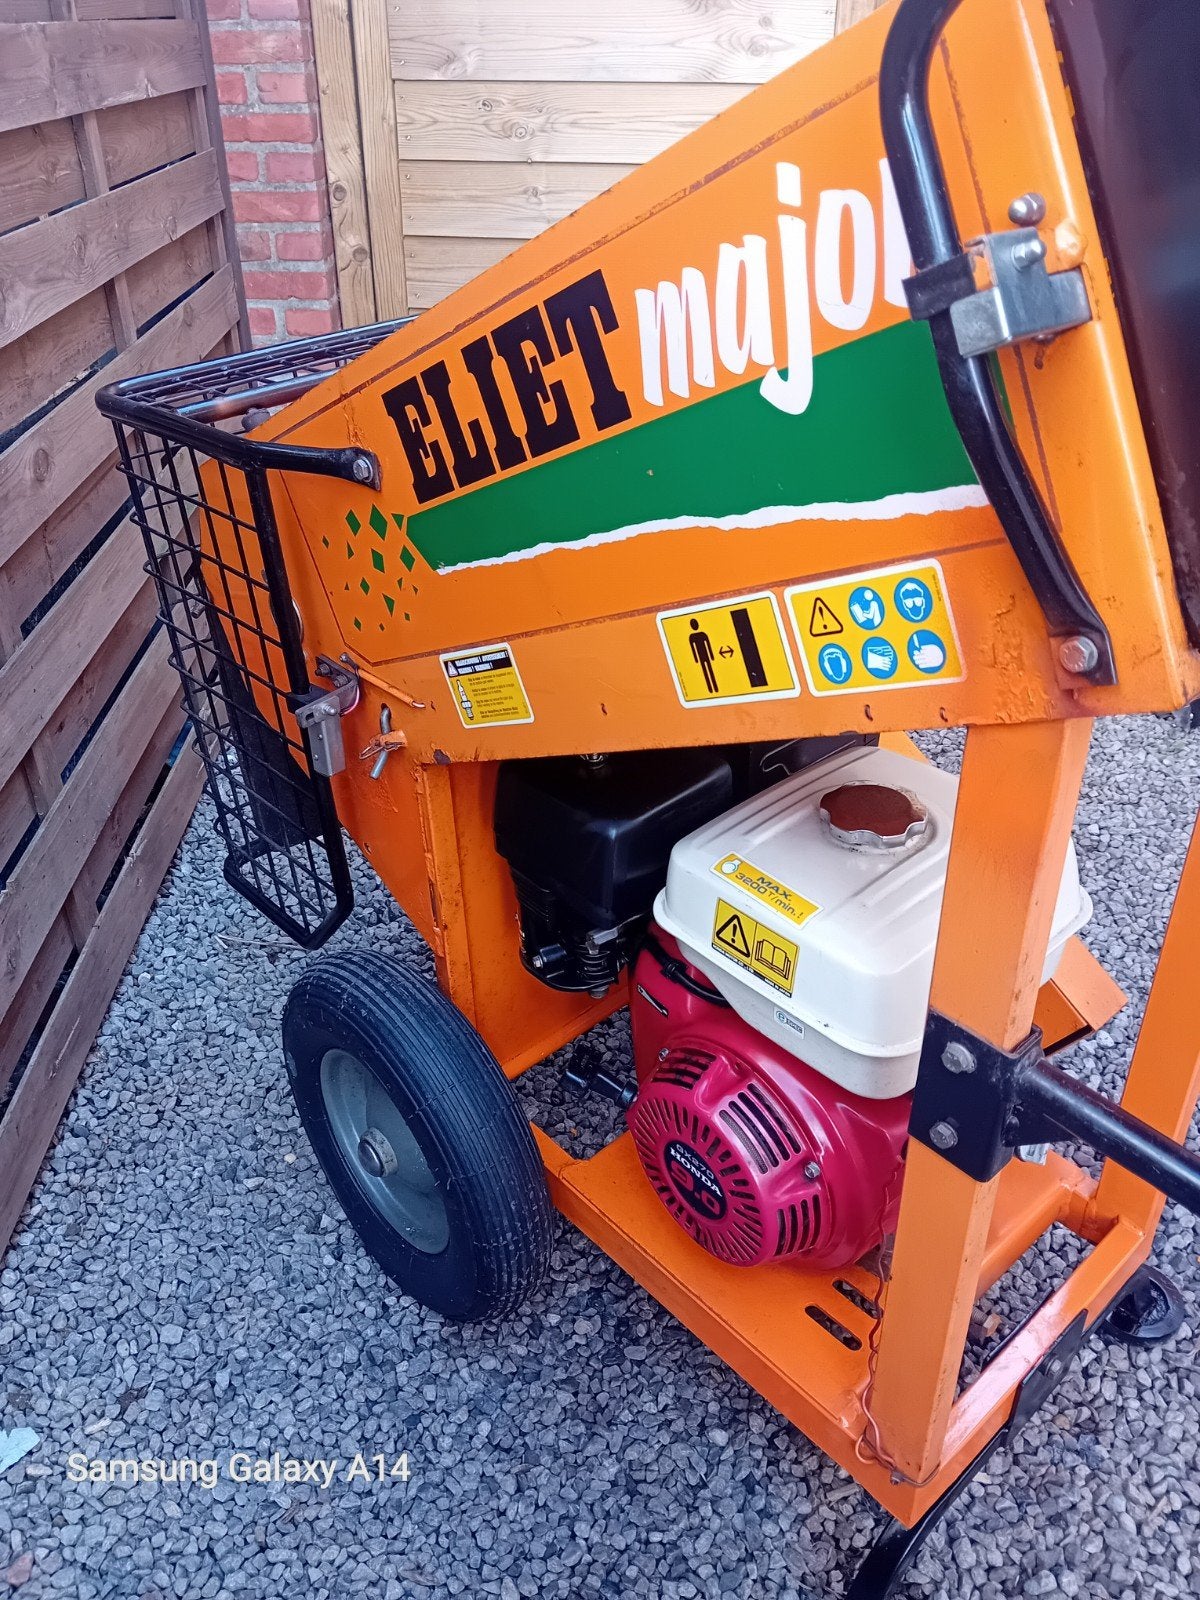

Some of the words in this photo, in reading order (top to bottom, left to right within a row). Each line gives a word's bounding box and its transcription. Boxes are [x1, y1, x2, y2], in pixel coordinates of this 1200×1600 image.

[381, 268, 632, 505] ELIET
[756, 876, 792, 902] MAX.
[669, 1146, 723, 1198] HONDA
[670, 1160, 721, 1215] 9.0
[676, 1143, 715, 1180] GX270
